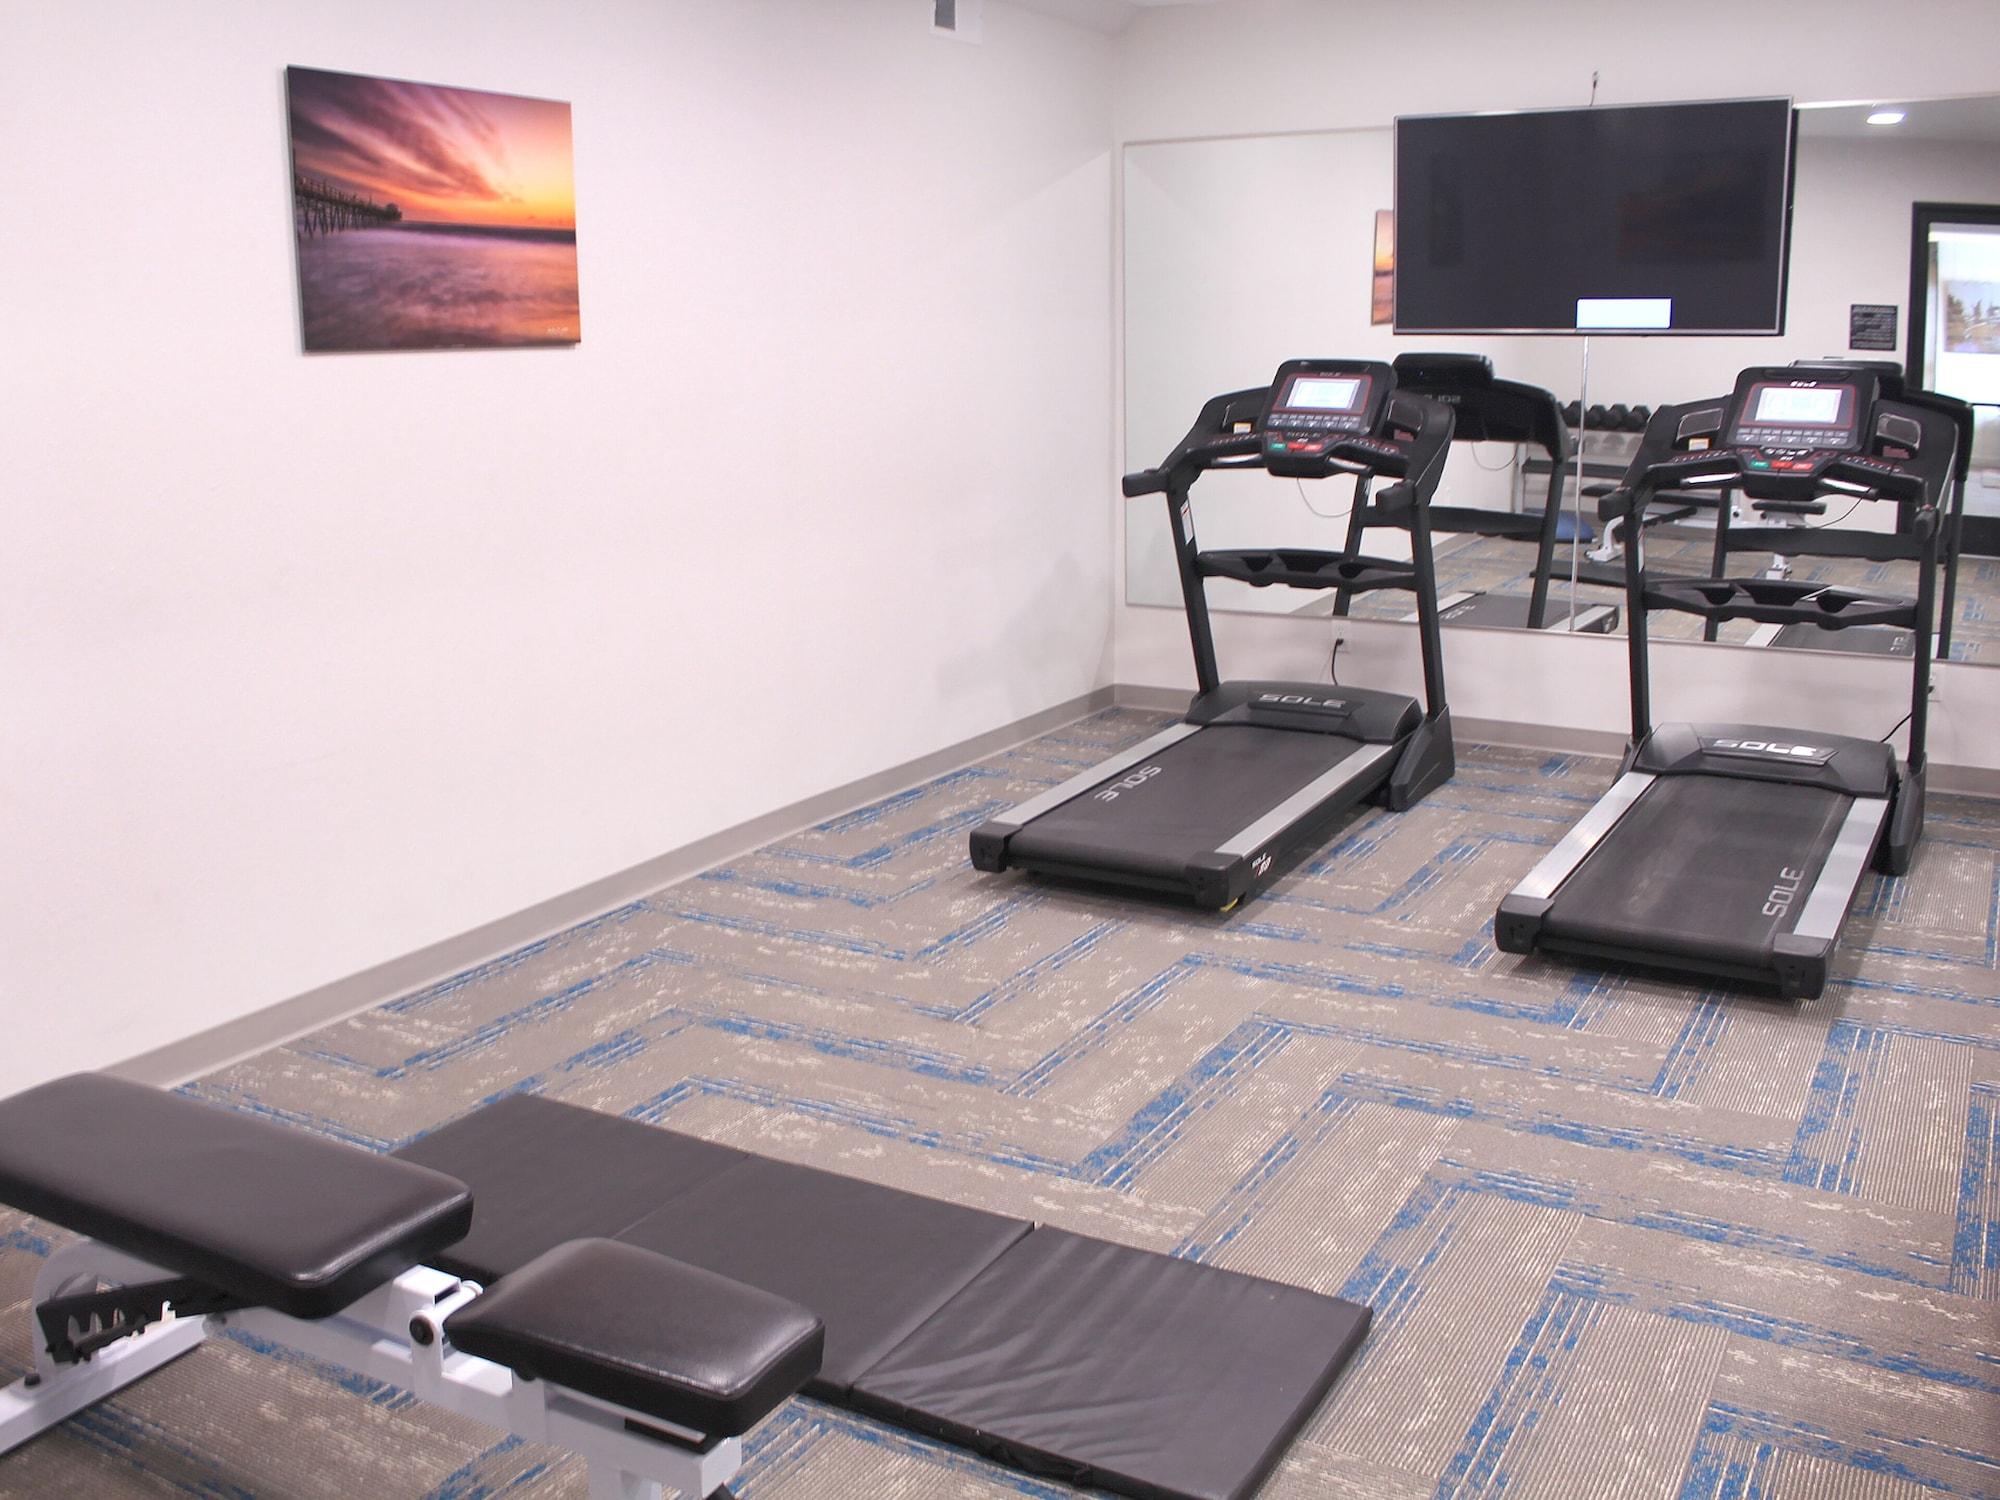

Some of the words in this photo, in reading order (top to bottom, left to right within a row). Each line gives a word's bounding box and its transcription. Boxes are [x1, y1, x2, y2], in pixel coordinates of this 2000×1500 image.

[1260, 693, 1346, 709] SOLE
[1713, 739, 1817, 757] SOLE
[1094, 765, 1162, 802] SOLE
[1762, 867, 1805, 918] SOLE
